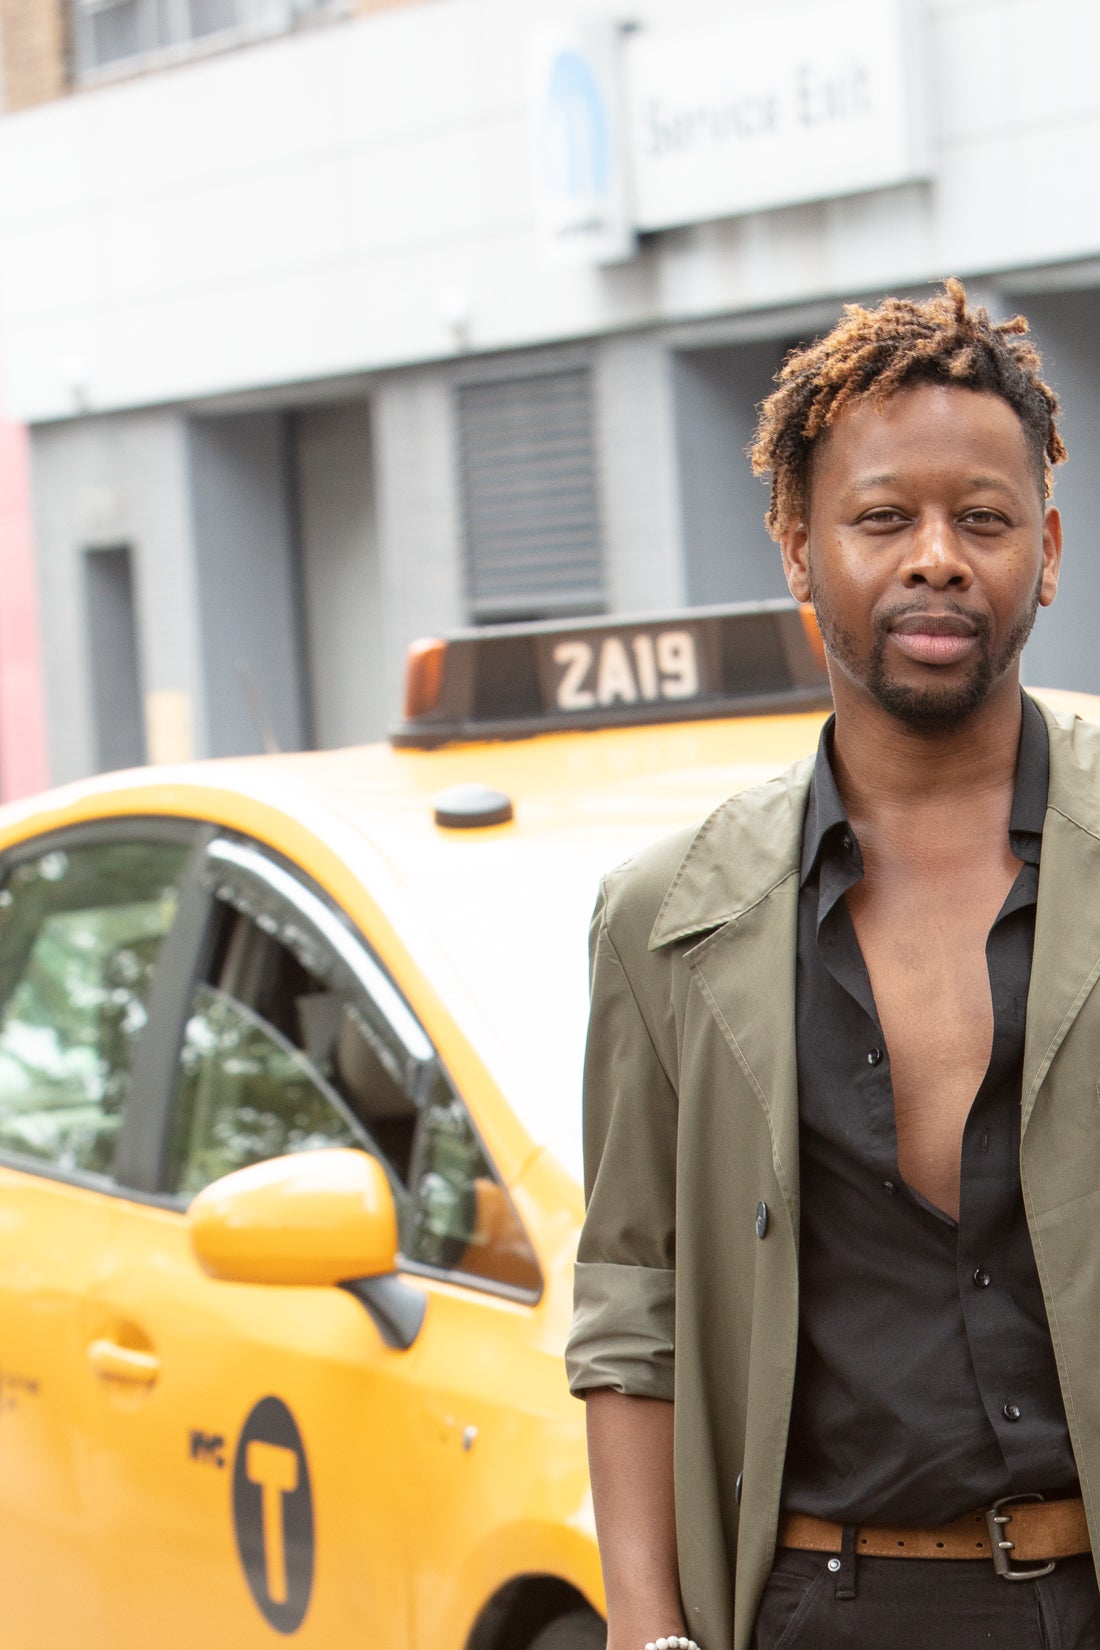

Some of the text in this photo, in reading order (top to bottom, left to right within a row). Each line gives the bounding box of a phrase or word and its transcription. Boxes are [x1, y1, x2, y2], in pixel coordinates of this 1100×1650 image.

[644, 61, 873, 159] Service Exit
[553, 631, 698, 711] 2A19
[246, 1438, 298, 1604] T
